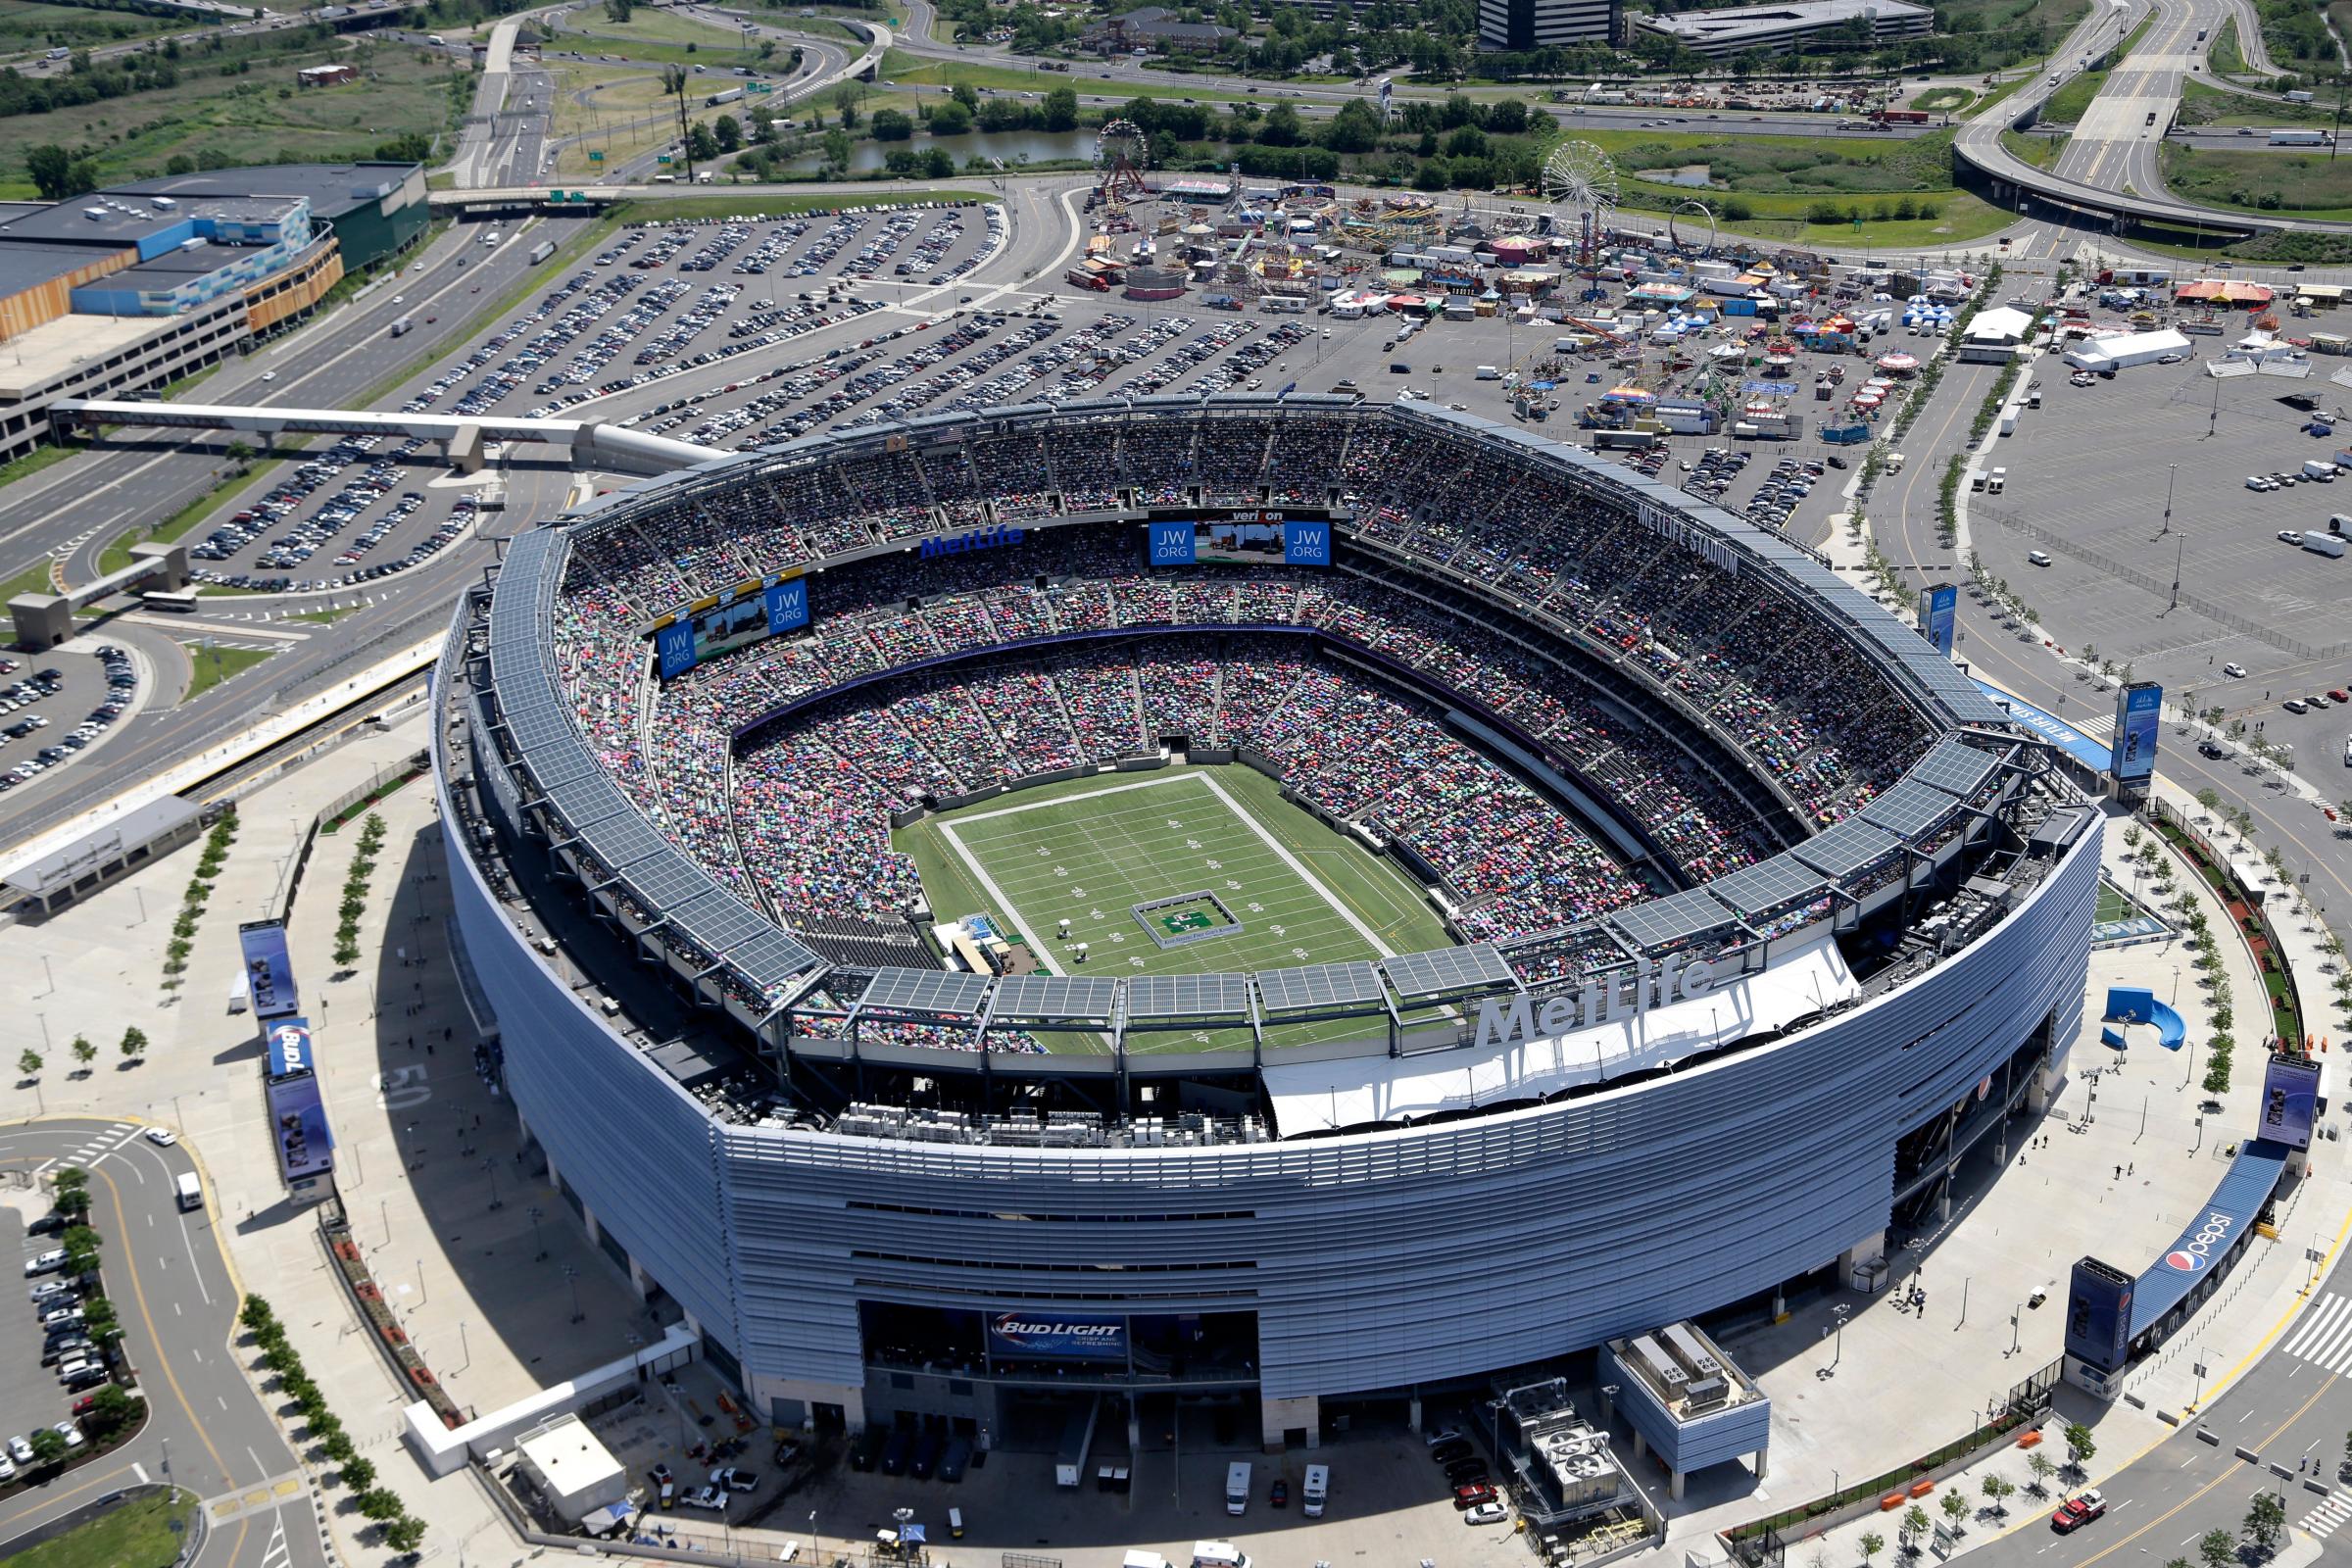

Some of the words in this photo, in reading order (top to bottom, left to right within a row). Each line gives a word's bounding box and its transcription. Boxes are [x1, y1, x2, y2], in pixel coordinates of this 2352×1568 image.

[1233, 510, 1283, 522] verizon
[920, 522, 1024, 559] MetLife
[1158, 530, 1187, 546] JW
[1293, 529, 1322, 545] JW
[1639, 504, 1686, 547] METLIFE
[1690, 529, 1739, 577] STADIUM
[1156, 546, 1188, 558] .ORG
[1291, 546, 1322, 558] .ORG
[774, 590, 800, 612] JW
[773, 608, 802, 626] .ORG
[666, 631, 687, 656] JW
[665, 649, 690, 669] .ORG
[2028, 715, 2080, 743] METLIFE
[1108, 932, 1124, 943] 50
[1474, 952, 1714, 1049] MetLife
[2187, 1212, 2233, 1256] pepsi
[1001, 1321, 1052, 1334] BUD
[1052, 1323, 1122, 1336] LIGHT
[2118, 1313, 2128, 1349] pepsi
